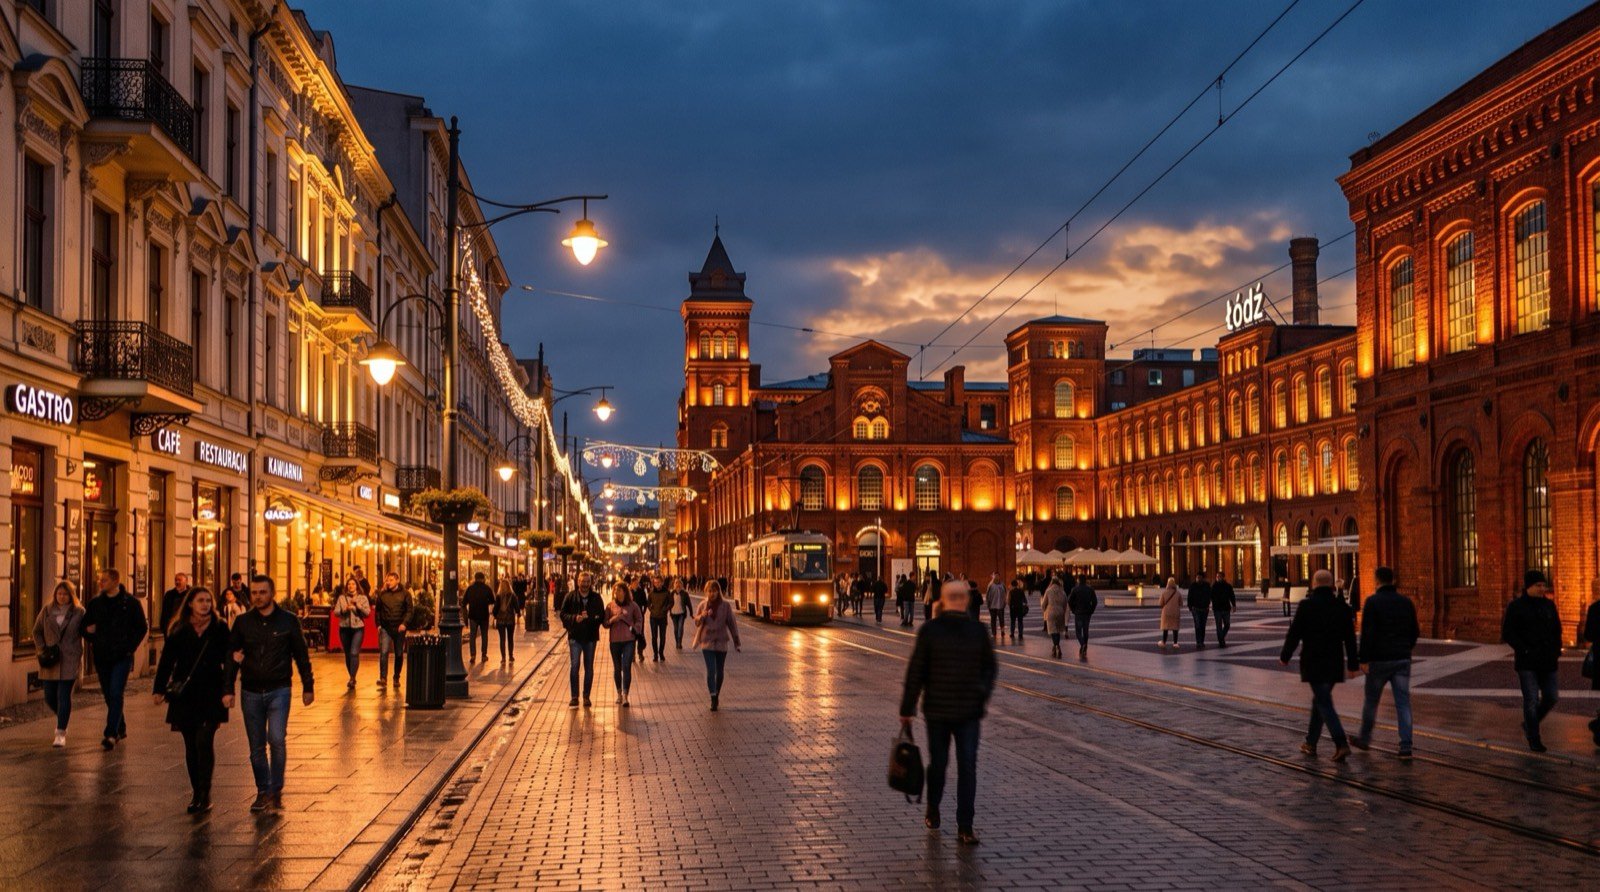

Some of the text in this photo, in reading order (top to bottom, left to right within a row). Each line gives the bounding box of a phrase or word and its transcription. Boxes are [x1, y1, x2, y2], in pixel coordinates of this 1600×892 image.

[15, 383, 73, 425] GASTRO
[158, 428, 181, 455] CAFÉ
[199, 441, 247, 474] RESTAURACJA
[268, 456, 303, 482] KAWIARNIA
